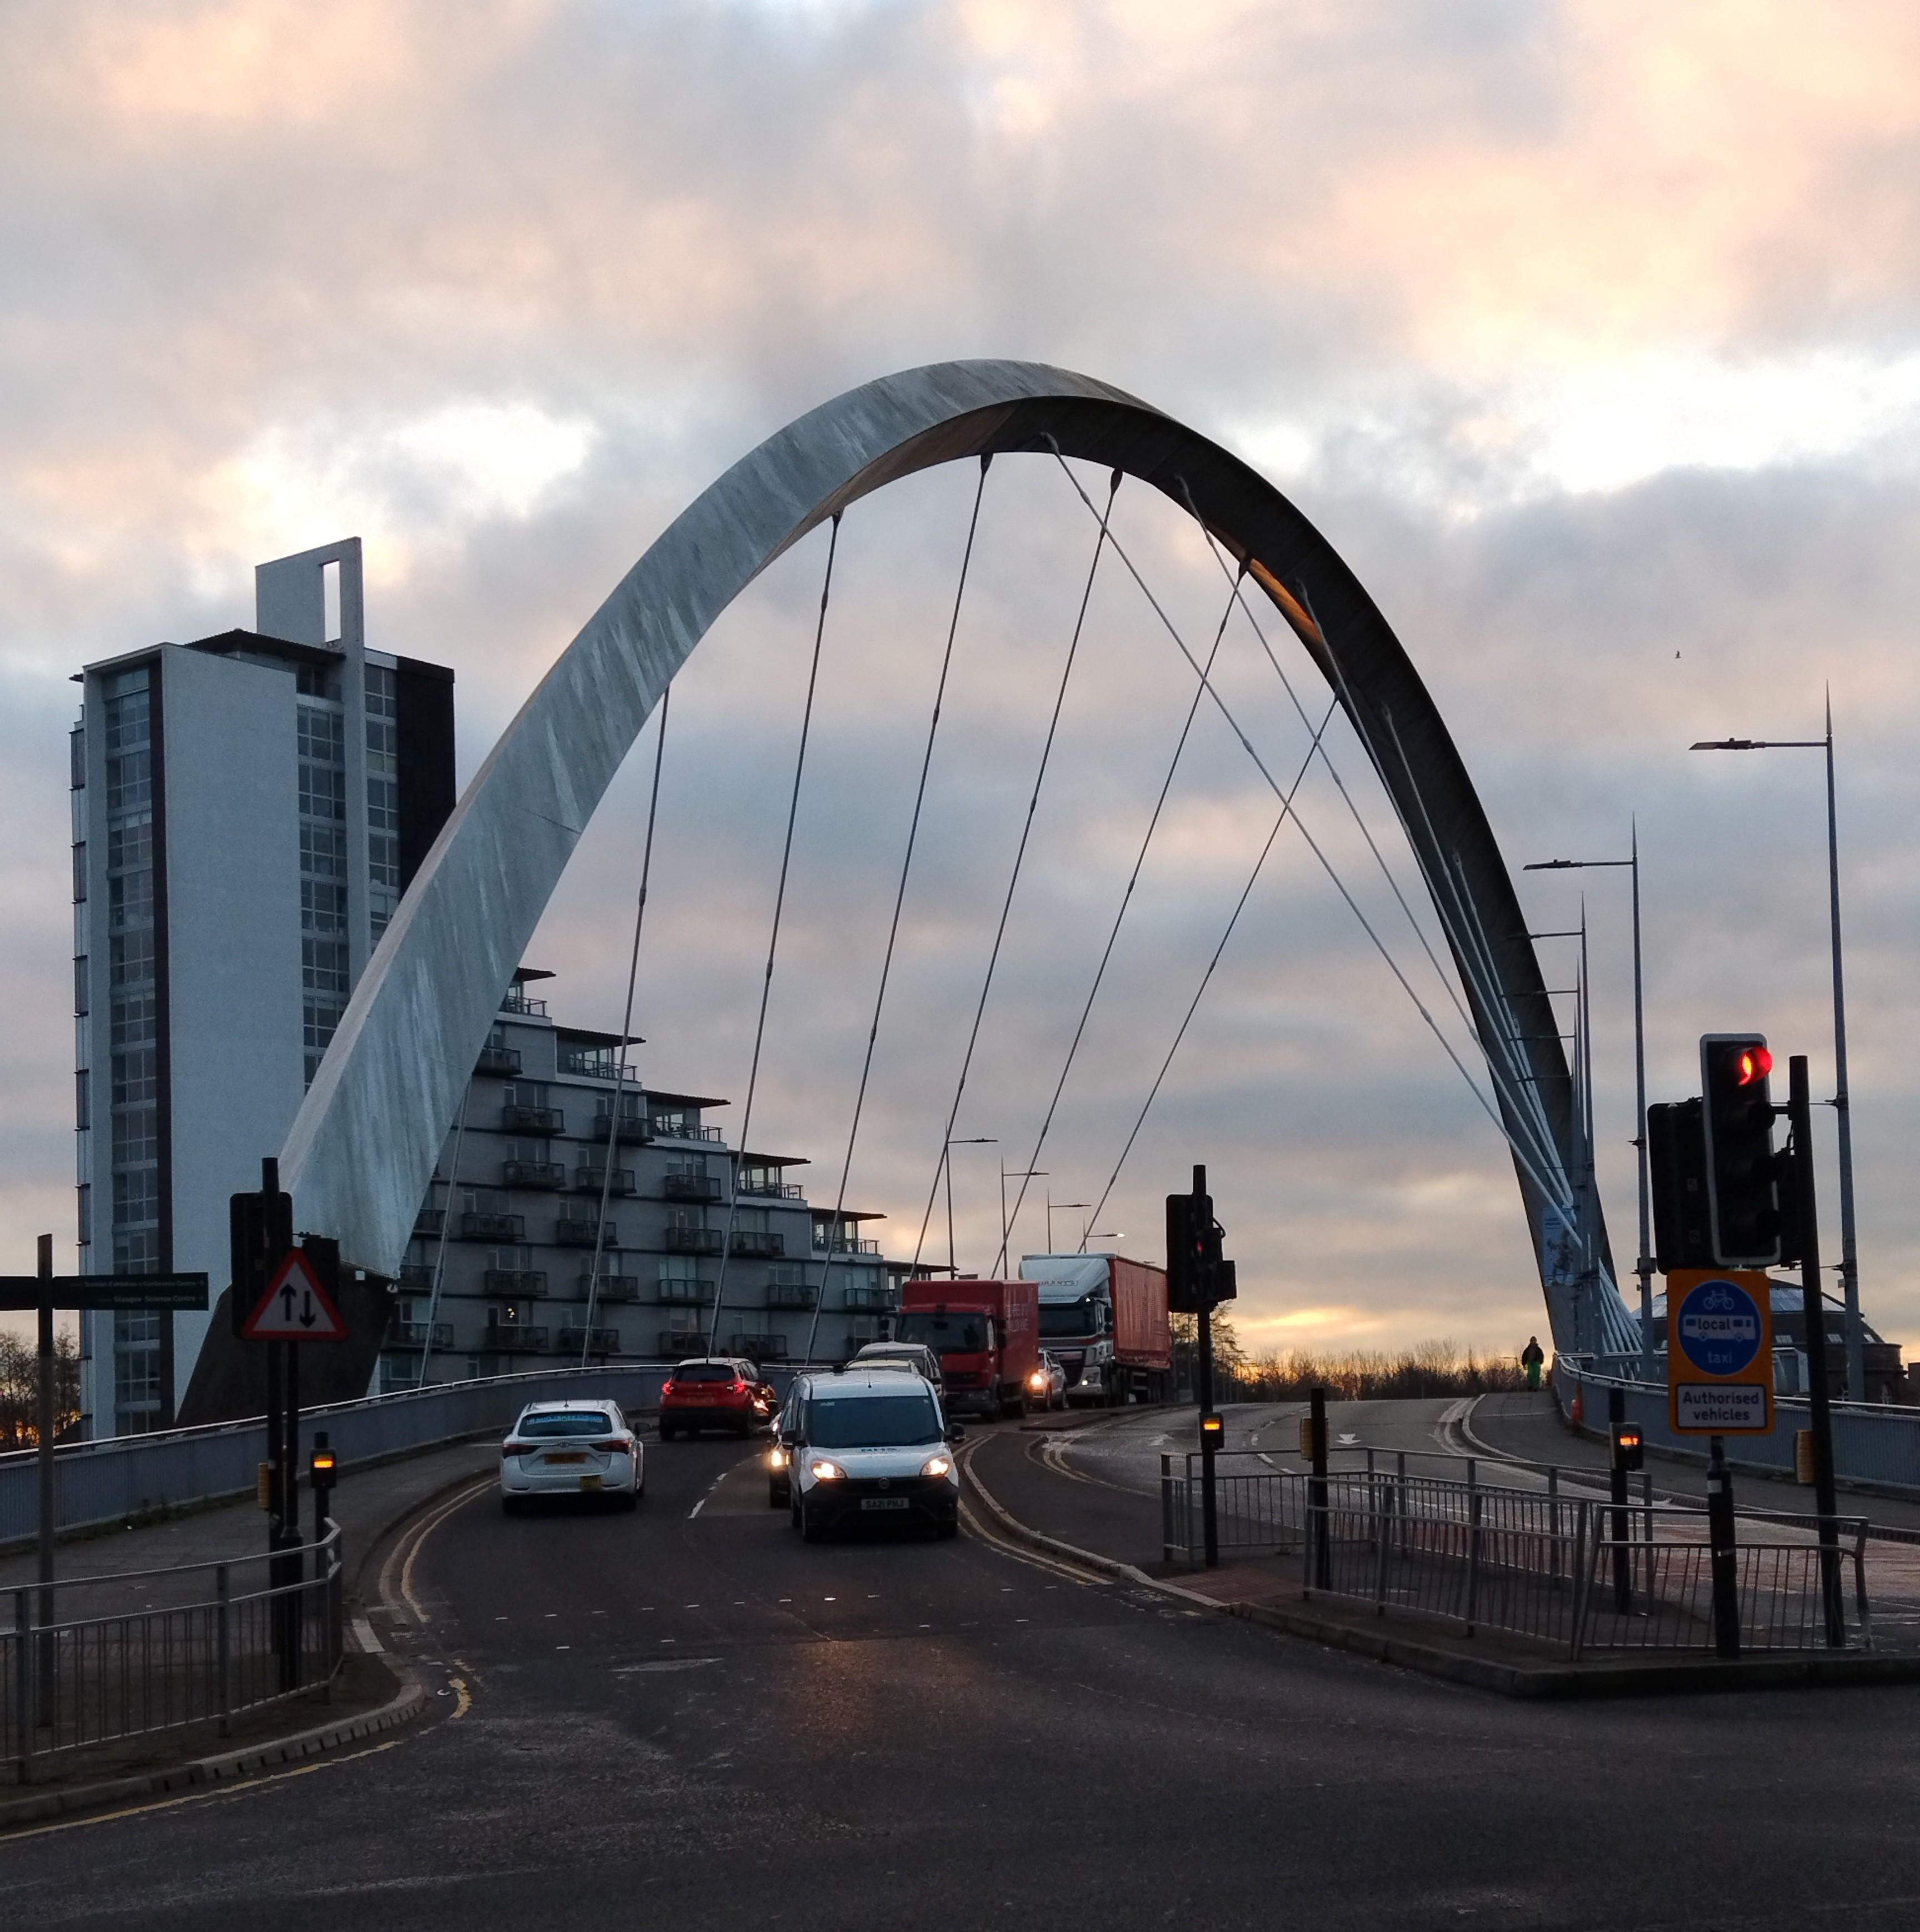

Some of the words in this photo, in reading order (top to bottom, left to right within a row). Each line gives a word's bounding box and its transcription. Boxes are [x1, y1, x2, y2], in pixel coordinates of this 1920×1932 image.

[1698, 1318, 1731, 1330] local
[1708, 1351, 1732, 1364] taxi
[1683, 1391, 1759, 1404] Authorised
[1694, 1408, 1750, 1421] vehicles
